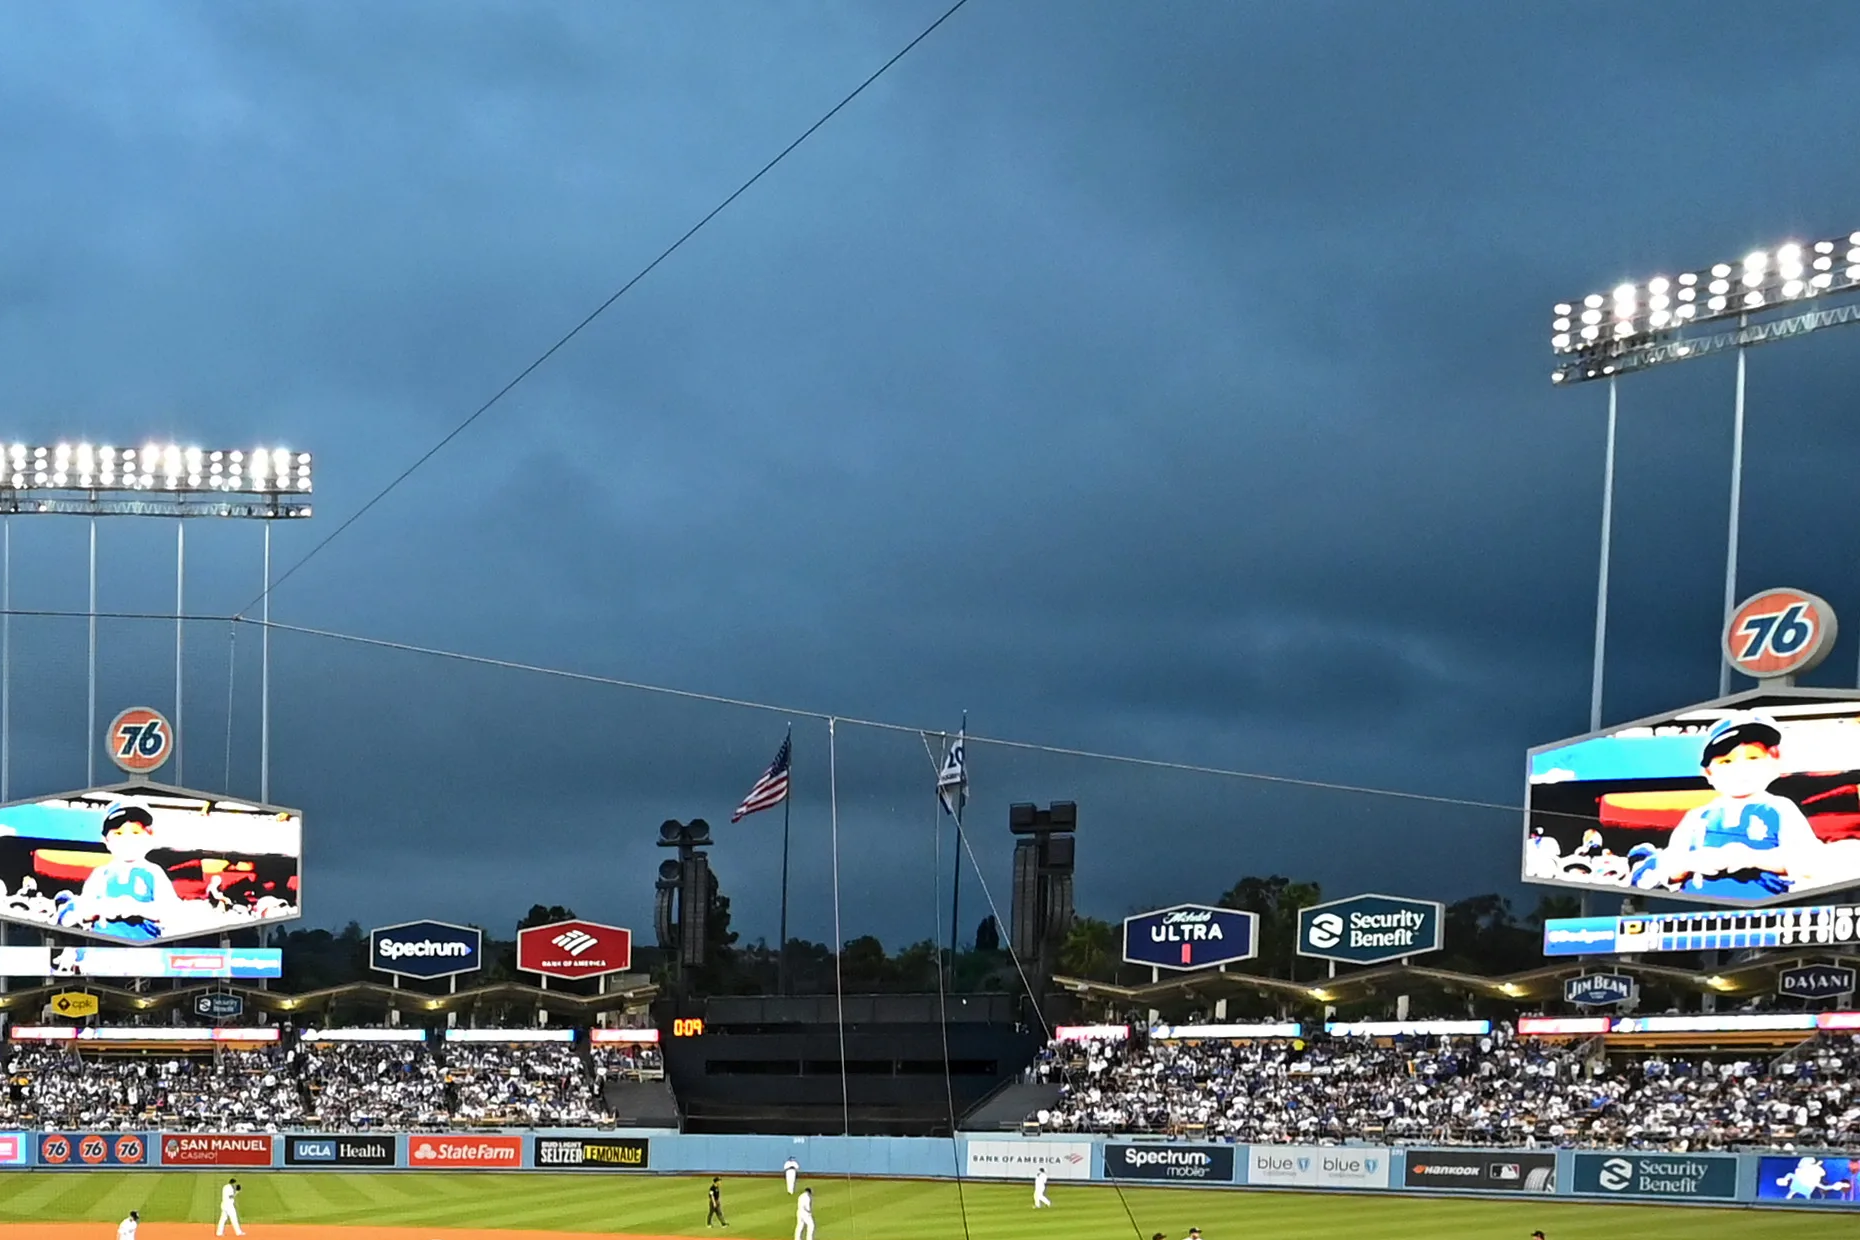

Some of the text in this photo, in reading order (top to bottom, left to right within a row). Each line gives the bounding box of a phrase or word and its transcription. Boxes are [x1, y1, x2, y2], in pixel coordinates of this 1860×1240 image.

[1737, 602, 1811, 662] 76
[117, 720, 165, 758] 76
[1350, 909, 1425, 931] Security
[1151, 923, 1224, 942] ULTRA
[1350, 928, 1414, 948] Benefit
[379, 938, 466, 960] Spectrum
[1568, 976, 1628, 1000] JIM BEAM
[1784, 973, 1849, 991] DASANI
[673, 1018, 703, 1036] 0:09
[47, 1142, 138, 1156] 76 76 76
[180, 1139, 267, 1150] SAN MANUEL
[298, 1144, 386, 1158] UCLA Health
[540, 1145, 642, 1163] SELTZER LEMONADE
[1002, 1155, 1013, 1163] OF
[1016, 1155, 1062, 1164] AMERICA
[1125, 1148, 1206, 1168] Spectrum
[1257, 1156, 1293, 1170] blue
[1166, 1165, 1206, 1177] mobile
[1323, 1158, 1360, 1172] blue
[1639, 1159, 1709, 1179] Security
[1639, 1176, 1697, 1192] Benefit
